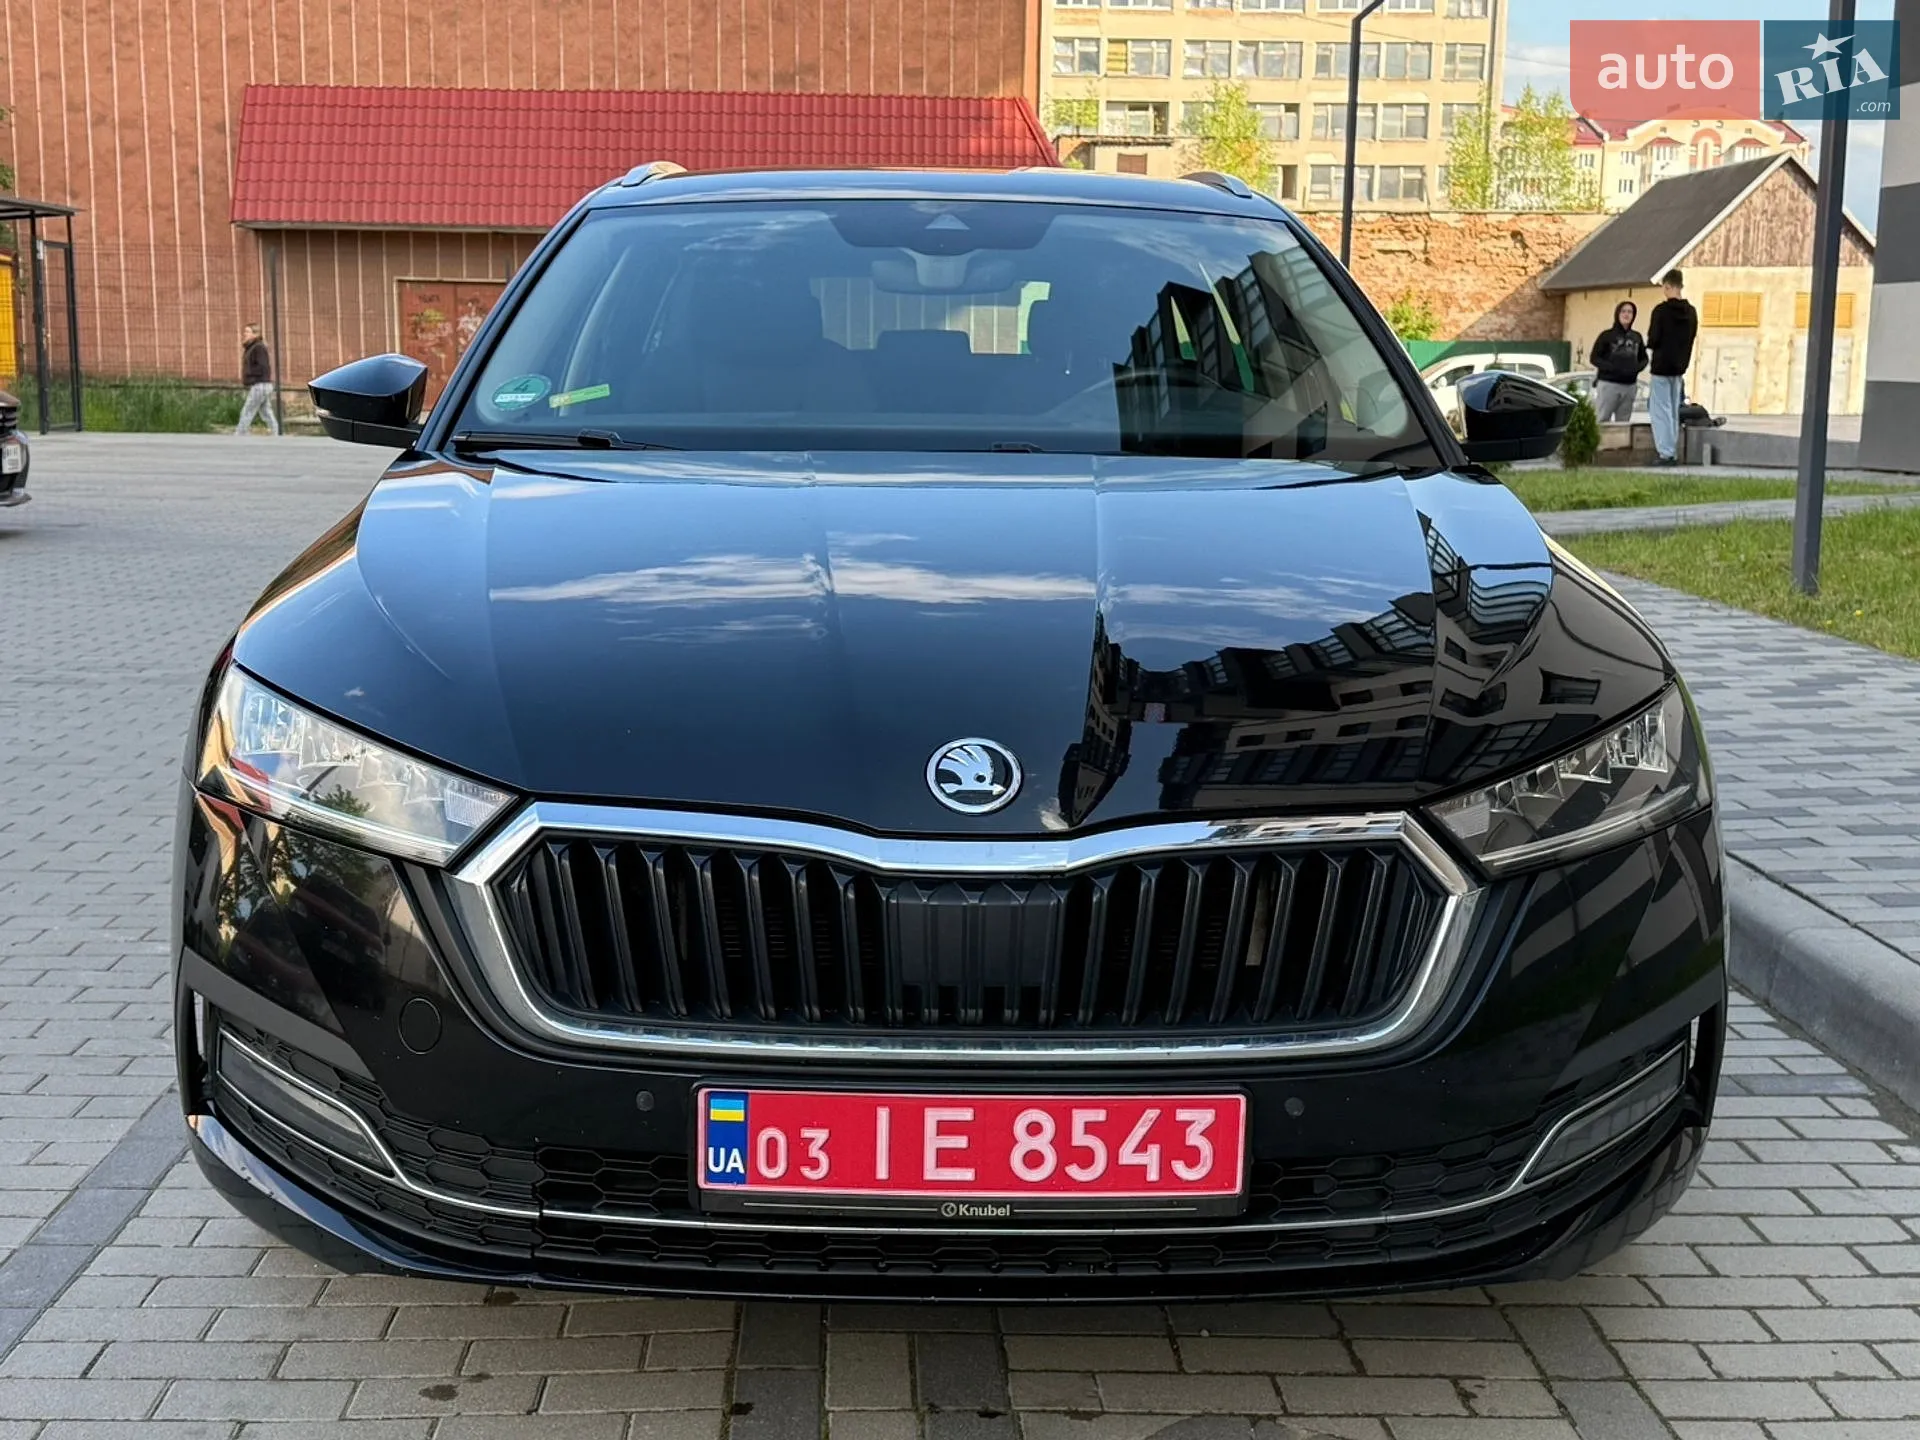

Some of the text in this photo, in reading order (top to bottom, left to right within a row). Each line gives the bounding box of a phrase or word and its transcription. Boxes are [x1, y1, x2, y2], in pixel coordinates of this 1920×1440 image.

[756, 1106, 1217, 1183] 03 IE 8543
[707, 1147, 746, 1174] UA
[958, 1203, 1012, 1217] Knubel
